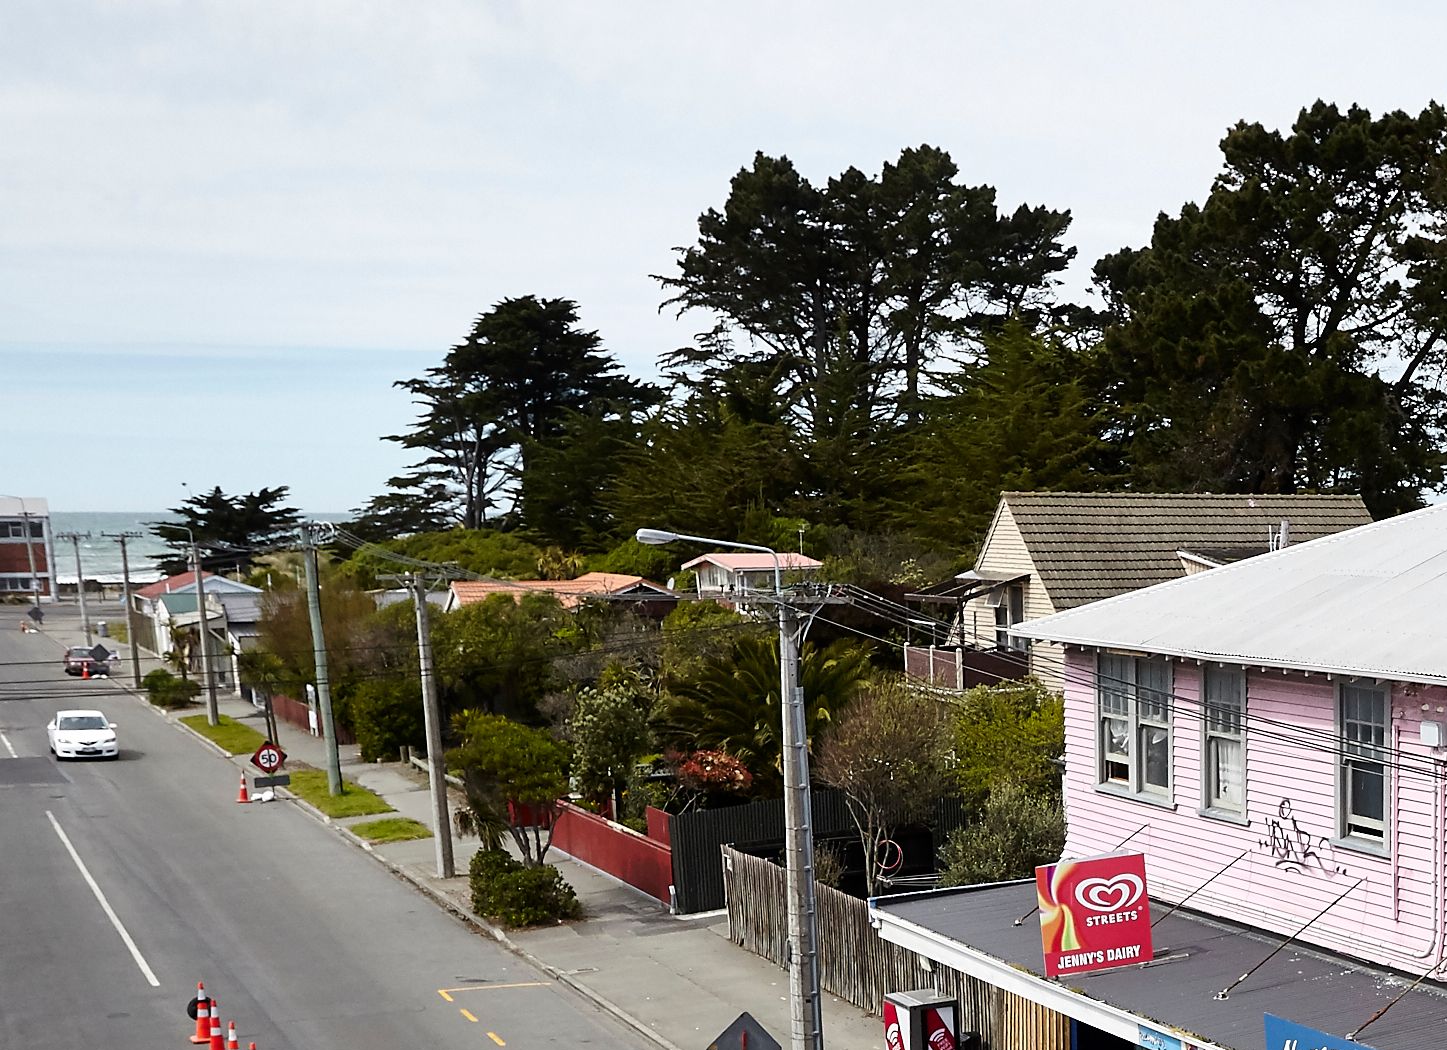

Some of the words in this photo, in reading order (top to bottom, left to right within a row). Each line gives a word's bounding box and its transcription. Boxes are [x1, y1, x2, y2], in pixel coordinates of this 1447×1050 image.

[261, 753, 277, 764] 50
[1086, 910, 1138, 927] STREETS
[1057, 950, 1104, 969] JENNY'S
[1106, 944, 1141, 961] DAIRY
